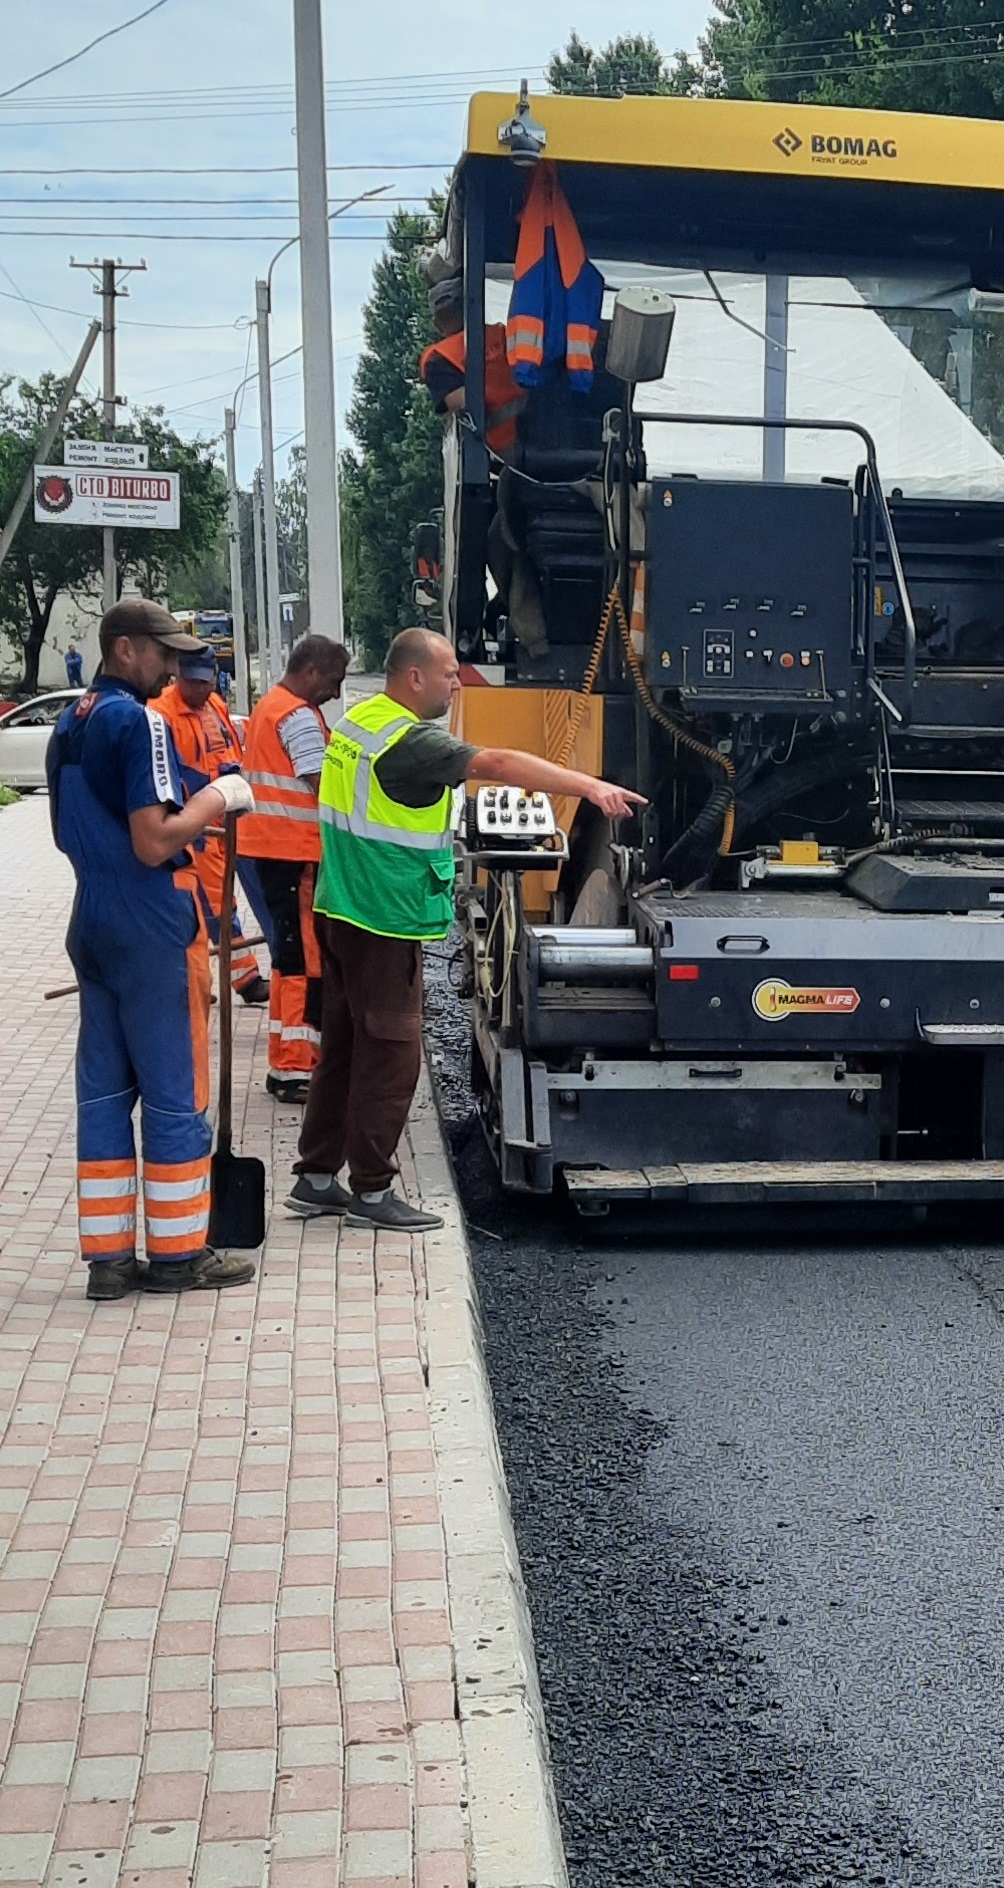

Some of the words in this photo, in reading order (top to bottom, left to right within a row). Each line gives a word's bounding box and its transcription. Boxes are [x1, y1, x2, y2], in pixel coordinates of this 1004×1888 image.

[811, 134, 898, 158] BOMAG
[838, 157, 868, 166] GROUP
[111, 478, 168, 499] BITURBO
